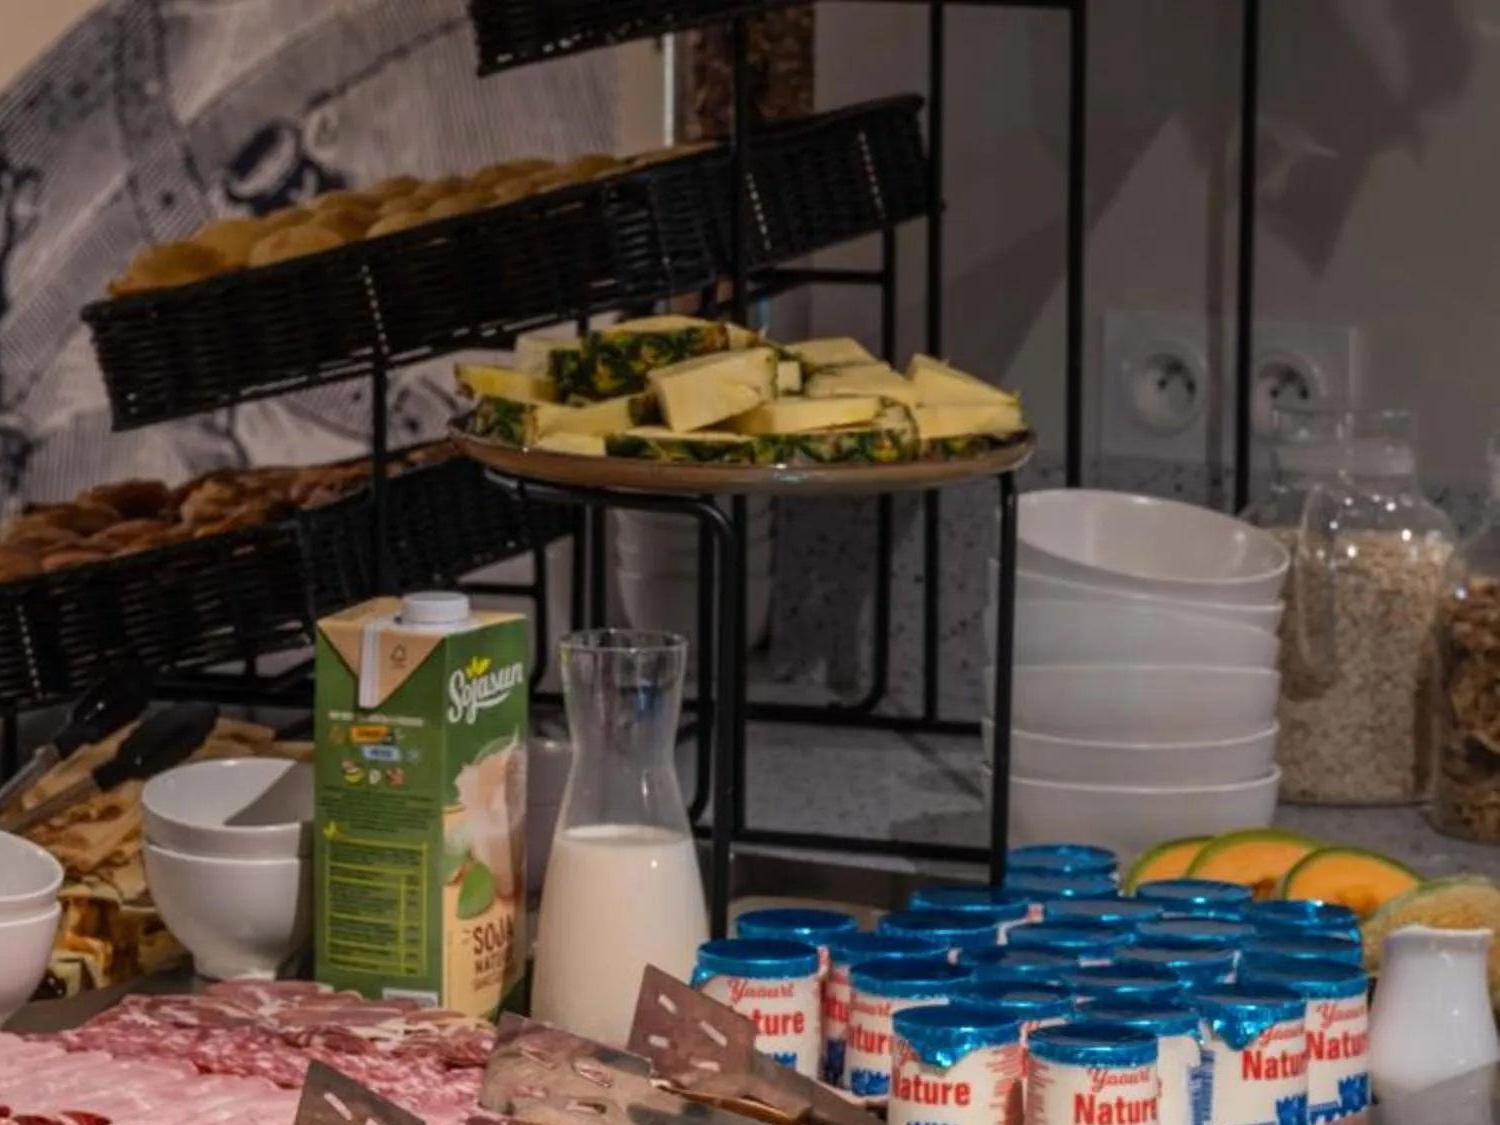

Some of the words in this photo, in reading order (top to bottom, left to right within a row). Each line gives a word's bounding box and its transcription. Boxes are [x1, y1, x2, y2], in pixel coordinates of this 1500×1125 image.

[448, 661, 523, 724] Sojasun
[727, 979, 795, 1005] Yaourt
[752, 1009, 804, 1035] ture
[1087, 1067, 1150, 1092] Yaourt
[1074, 1093, 1157, 1125] Natur
